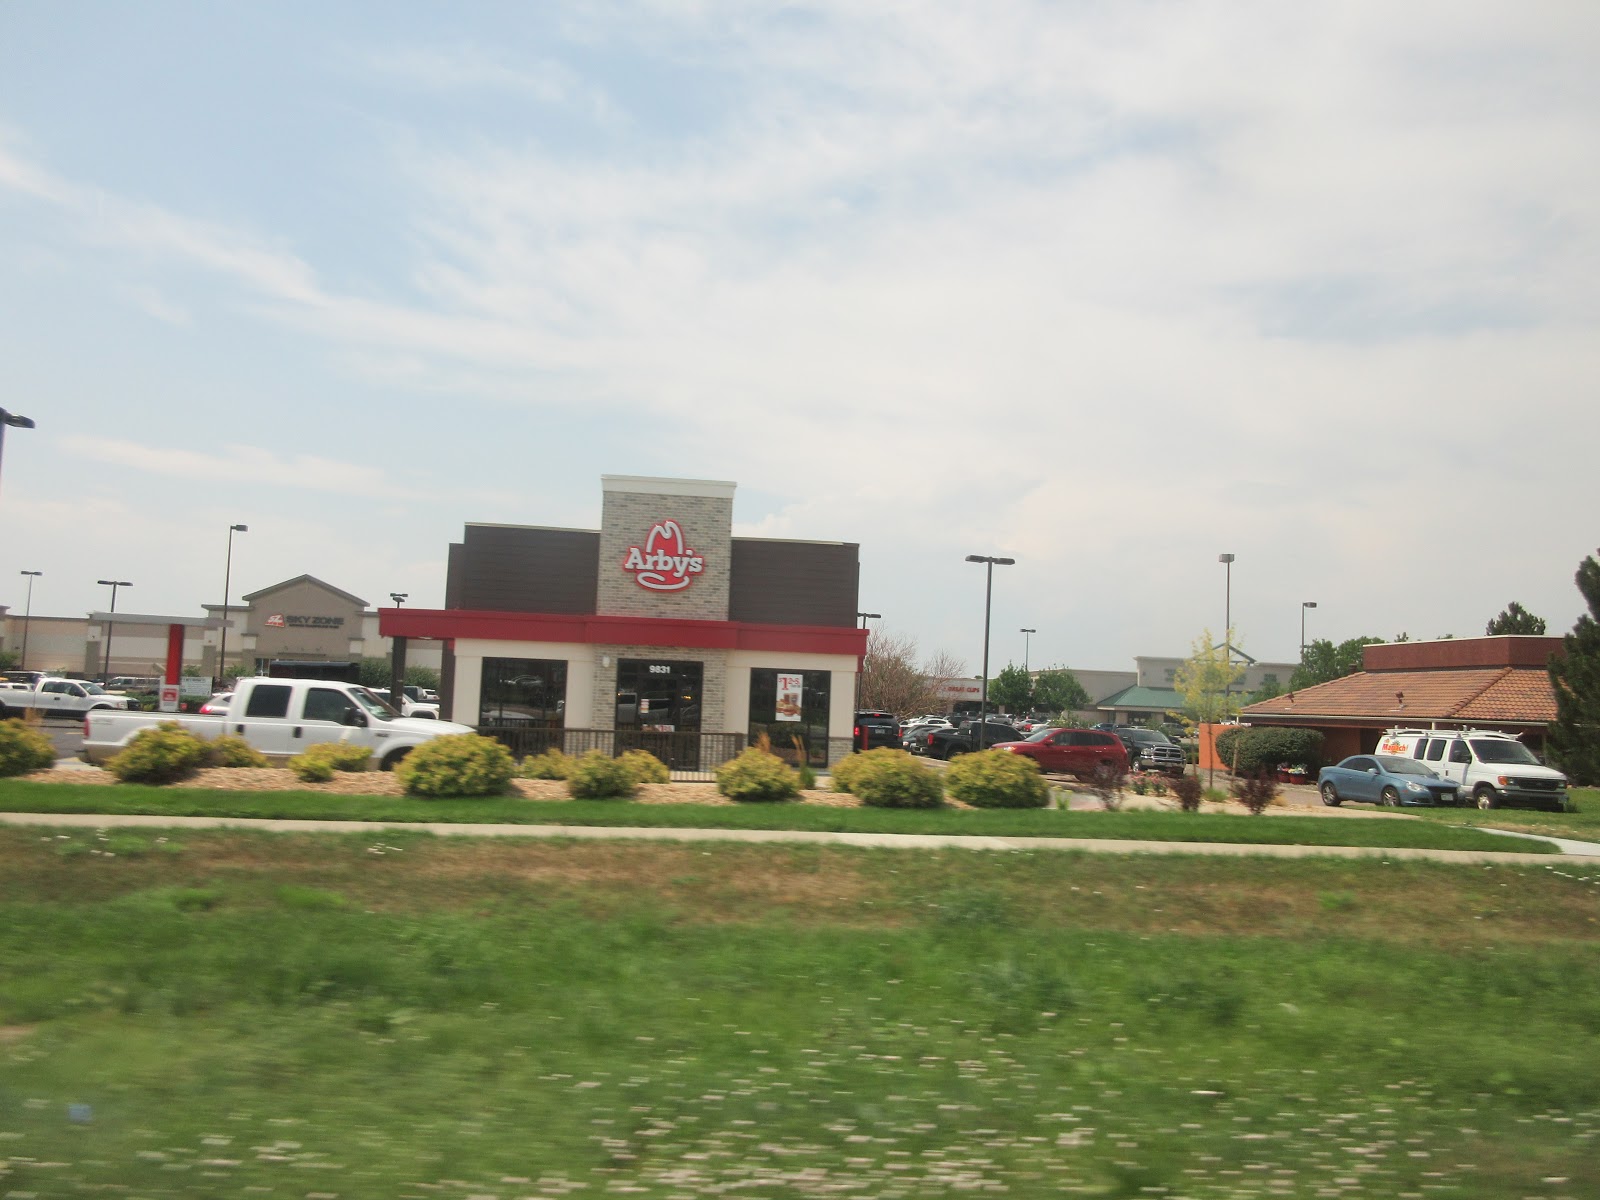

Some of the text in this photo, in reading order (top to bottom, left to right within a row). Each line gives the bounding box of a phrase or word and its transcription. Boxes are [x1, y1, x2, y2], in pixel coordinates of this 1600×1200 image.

[625, 547, 703, 578] Arby's
[286, 615, 345, 625] SKY ZONE
[649, 665, 671, 674] 9831
